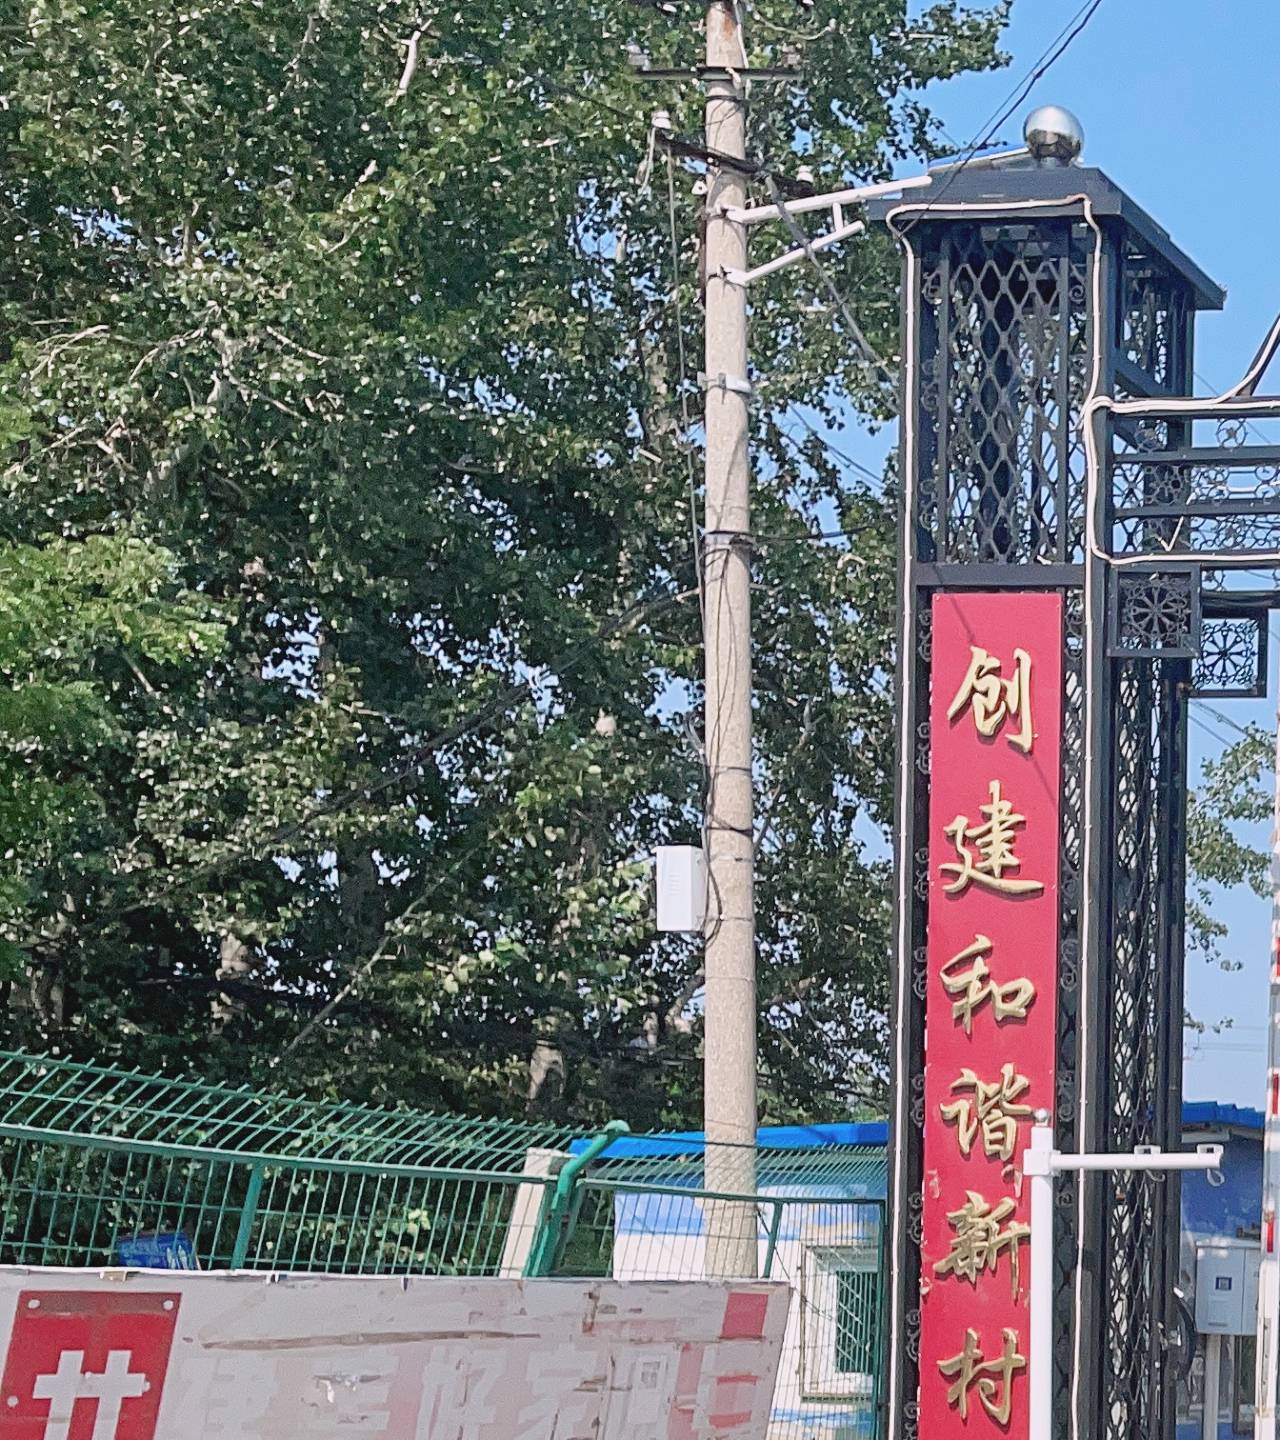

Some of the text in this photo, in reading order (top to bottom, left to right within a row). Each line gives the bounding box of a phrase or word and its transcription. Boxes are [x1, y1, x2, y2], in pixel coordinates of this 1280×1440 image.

[934, 645, 1045, 1425] 创建和谐新村
